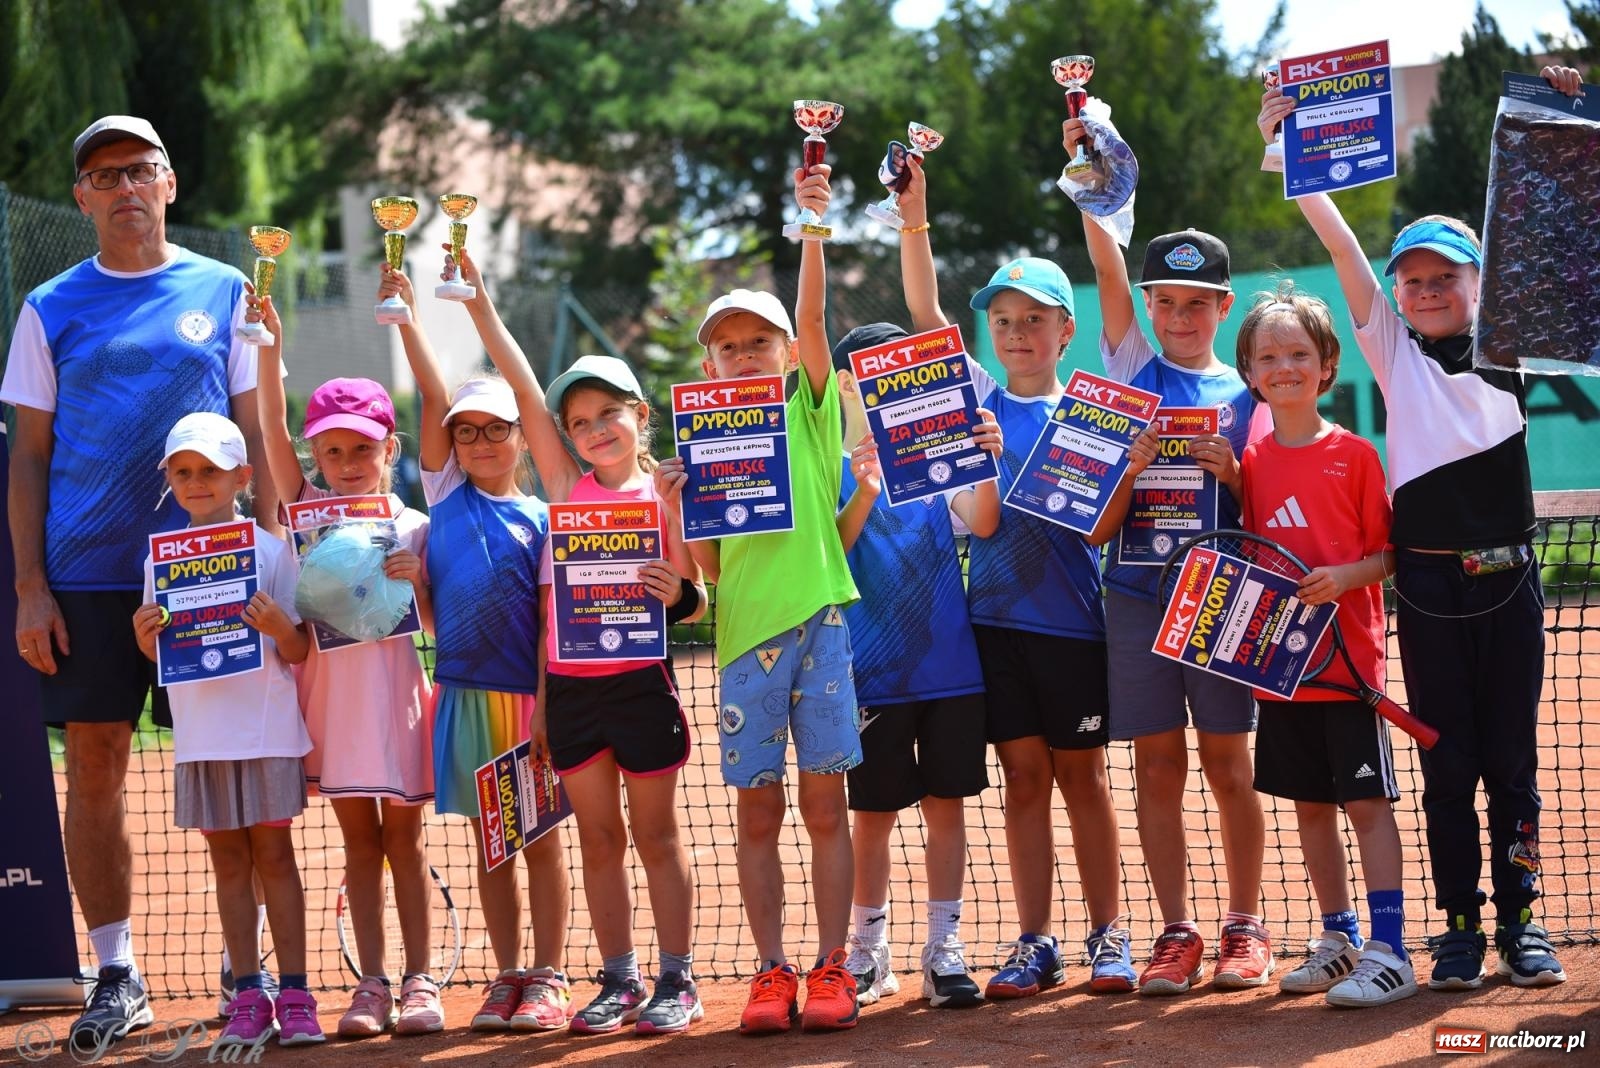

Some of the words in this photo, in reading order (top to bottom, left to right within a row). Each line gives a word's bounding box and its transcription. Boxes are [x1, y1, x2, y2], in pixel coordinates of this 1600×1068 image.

[1344, 51, 1375, 63] SUMMER
[1288, 57, 1343, 80] RKT
[1300, 73, 1370, 100] DYPLOM
[1302, 128, 1315, 141] III
[1320, 118, 1375, 139] MIEJSCE
[1330, 134, 1354, 143] TURNIEJU
[1314, 144, 1336, 152] SUMMER
[916, 338, 946, 352] SUMMER
[919, 350, 934, 358] KIDS
[860, 346, 916, 375] RKT
[876, 362, 948, 396] DYPLOM
[681, 388, 736, 408] RKT
[738, 385, 768, 395] SUMMER
[911, 387, 924, 395] DLA
[1072, 379, 1121, 404] RKT
[1121, 393, 1145, 407] SUMMER
[693, 409, 764, 432] DYPLOM
[888, 425, 911, 443] ZA
[914, 410, 968, 435] UDZIAŁ
[1069, 402, 1130, 434] DYPLOM
[1174, 416, 1203, 424] SUMMER
[907, 442, 930, 452] SUMMER
[931, 439, 942, 447] KIDS
[943, 435, 953, 443] CUP
[954, 432, 967, 440] 2025
[922, 431, 946, 441] TURNIEJU
[701, 465, 707, 478] I
[710, 459, 766, 477] MIEJSCE
[1048, 447, 1062, 460] III
[1063, 450, 1109, 477] MIEJSCE
[1050, 466, 1069, 477] SUMMER
[1136, 491, 1143, 504] II
[1145, 490, 1196, 505] MIEJSCE
[296, 504, 349, 525] RKT
[558, 511, 613, 528] RKT
[212, 531, 240, 542] SUMMER
[569, 533, 639, 553] DYPLOM
[159, 536, 210, 558] RKT
[169, 554, 237, 581] DYPLOM
[1186, 562, 1201, 592] SUMMER
[572, 587, 586, 600] III
[590, 584, 645, 600] MIEJSCE
[171, 612, 192, 626] ZA
[1164, 592, 1196, 650] RKT
[1190, 577, 1231, 649] DYPLOM
[1219, 609, 1227, 622] DLA
[186, 629, 208, 637] SUMMER
[201, 620, 224, 628] TURNIEJU
[1235, 642, 1254, 666] ZA
[1246, 589, 1278, 640] UDZIAŁ
[499, 774, 517, 841] DYPLOM
[487, 810, 502, 860] RKT
